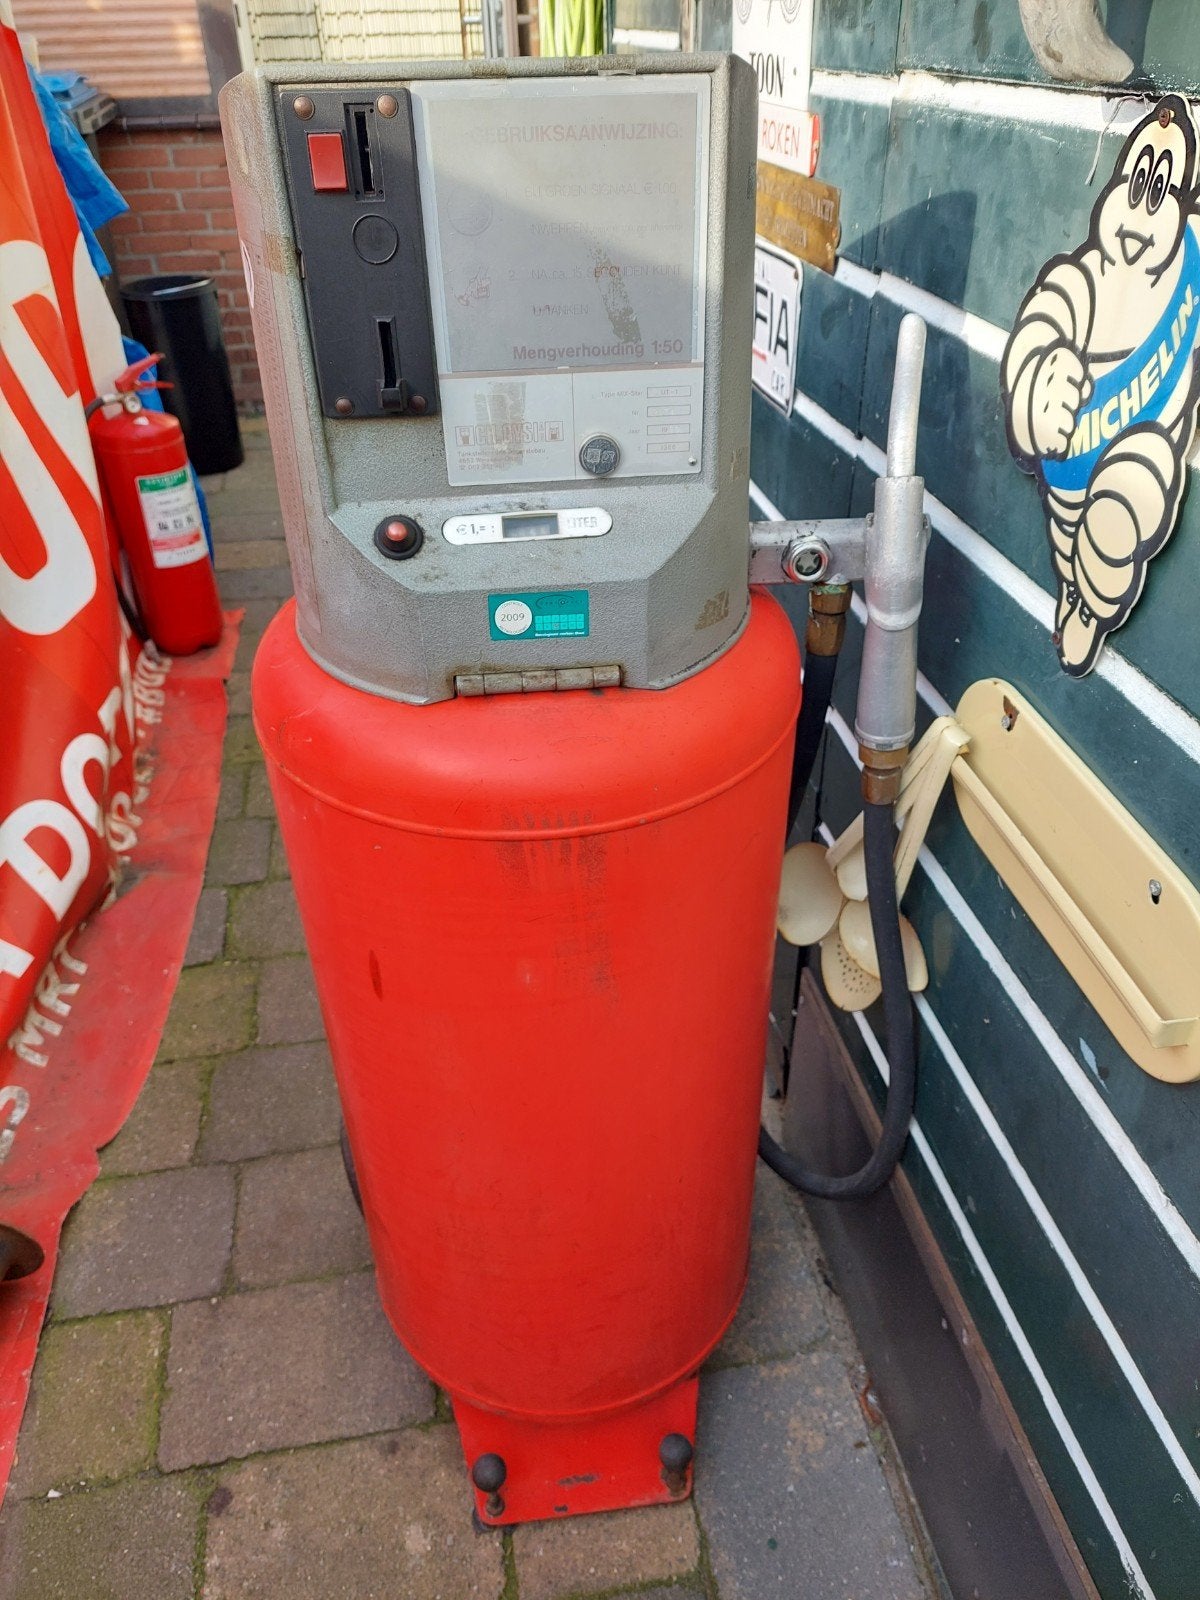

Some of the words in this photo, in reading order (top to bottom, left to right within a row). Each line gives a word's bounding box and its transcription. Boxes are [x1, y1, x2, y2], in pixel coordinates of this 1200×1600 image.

[762, 118, 801, 158] ROKEN
[513, 342, 645, 361] Mengverhouding
[651, 338, 683, 354] 1:50
[1067, 283, 1194, 460] MICHELIN
[501, 612, 526, 622] 2009
